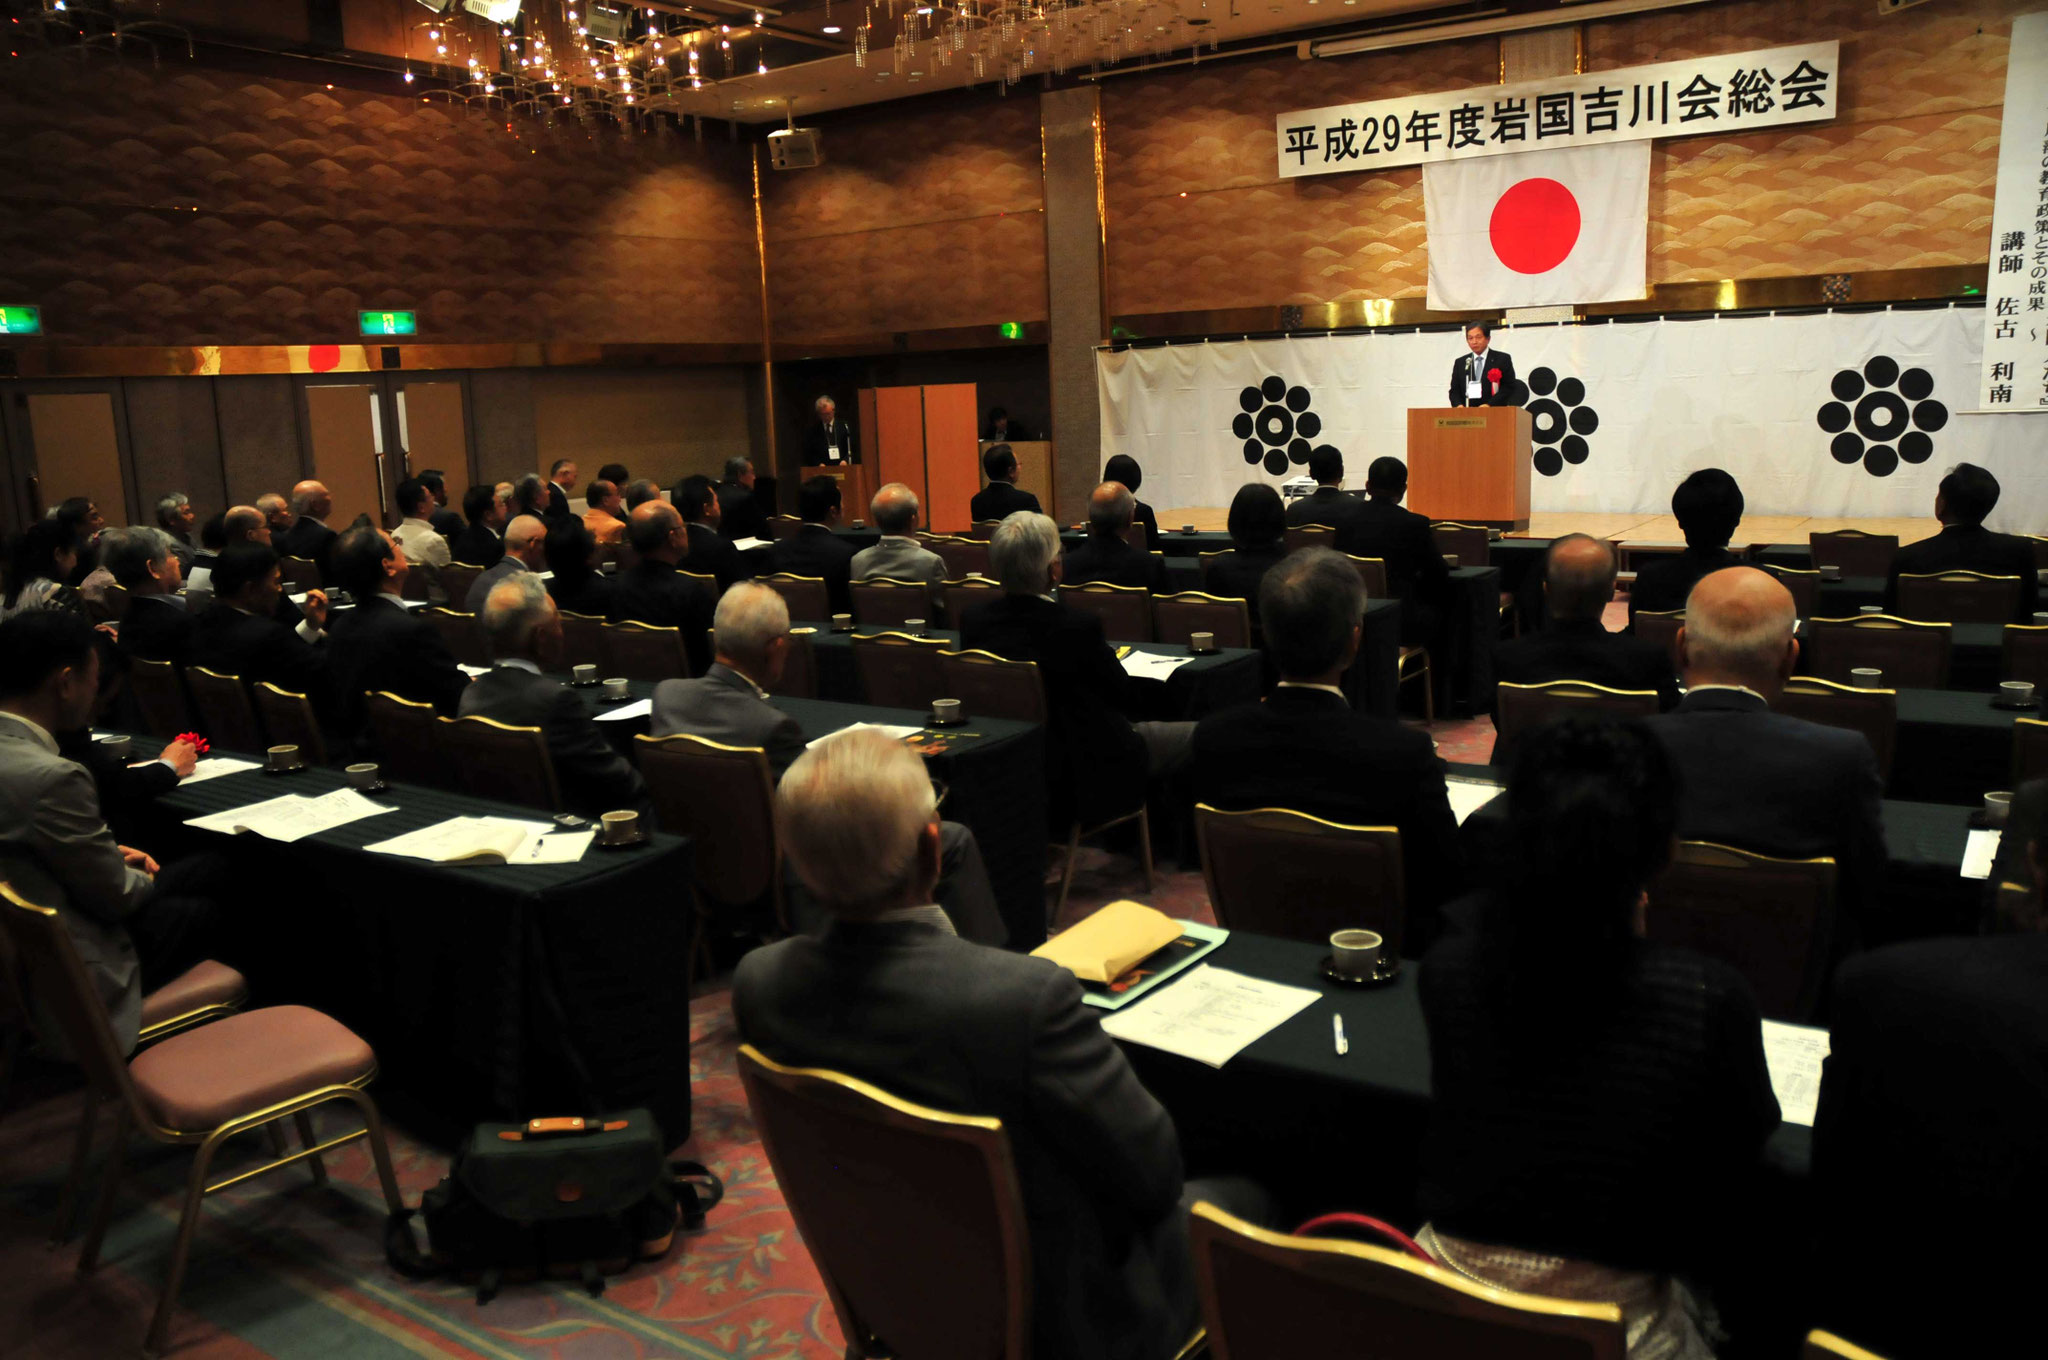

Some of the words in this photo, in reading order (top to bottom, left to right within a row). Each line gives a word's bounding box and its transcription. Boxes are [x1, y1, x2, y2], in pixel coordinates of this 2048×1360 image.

[1284, 59, 1830, 166] 平成29年度岩国吉川会総会
[1999, 231, 2026, 274] 講師
